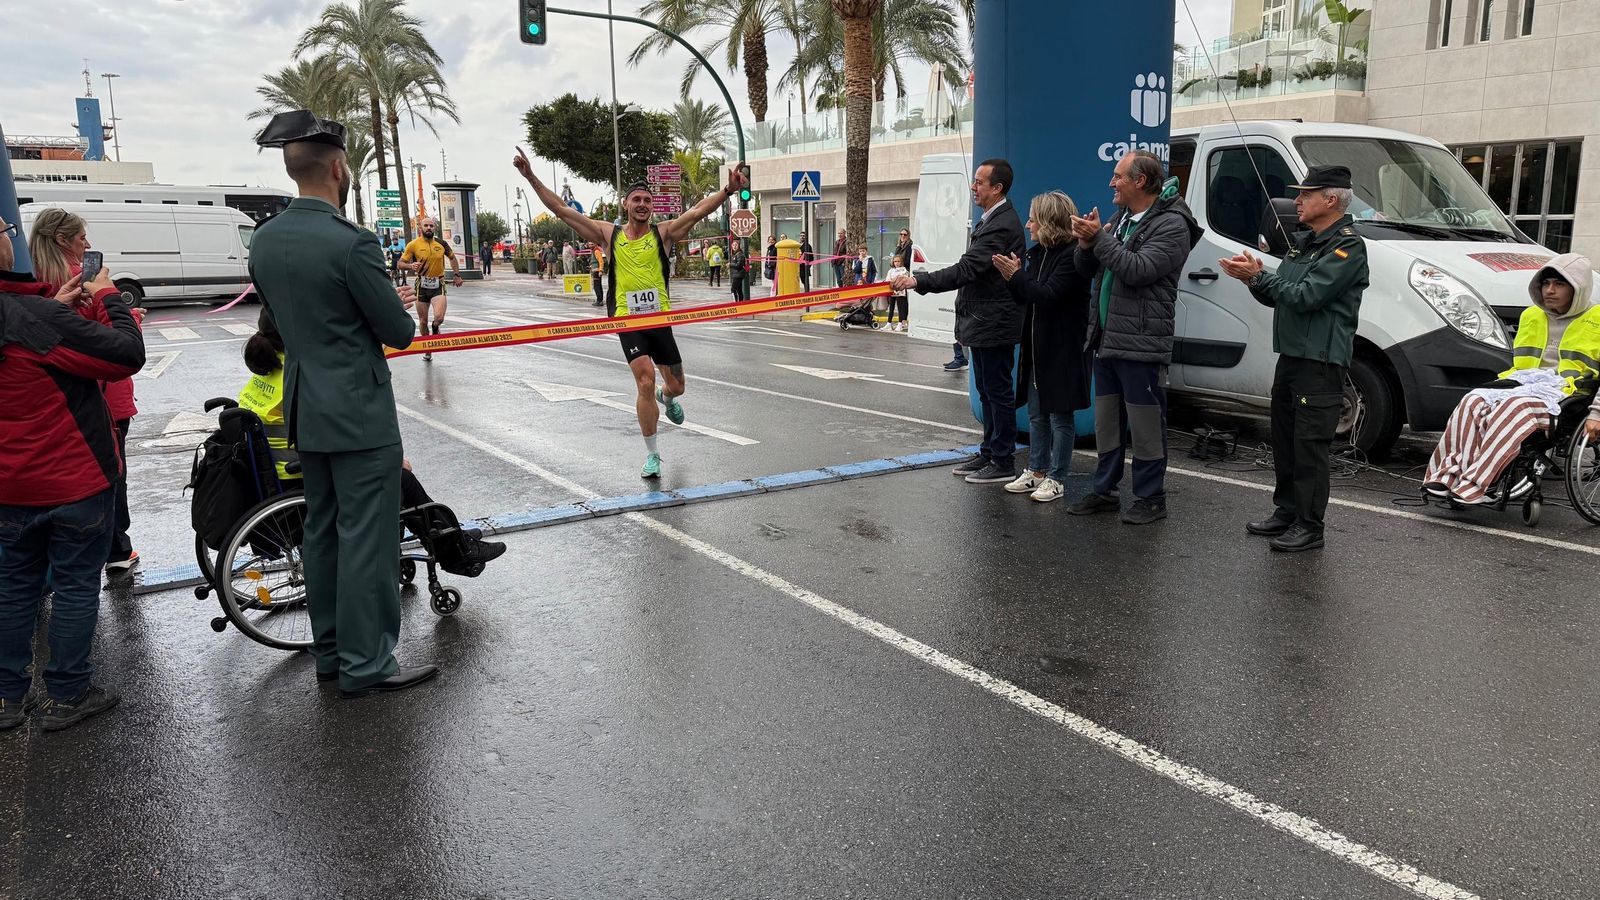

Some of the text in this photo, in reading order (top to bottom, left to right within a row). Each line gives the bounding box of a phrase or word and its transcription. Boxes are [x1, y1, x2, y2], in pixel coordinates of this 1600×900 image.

[731, 217, 756, 229] STOP
[632, 291, 655, 304] 140
[689, 311, 710, 319] SOLIDARIA
[552, 326, 573, 334] CARRERA
[573, 324, 596, 333] SOLIDARIA
[616, 321, 627, 329] 2025
[428, 339, 451, 348] CARRERA
[452, 336, 478, 346] SOLIDARIA
[478, 333, 500, 344] ALMERÍA
[500, 333, 513, 341] 2025
